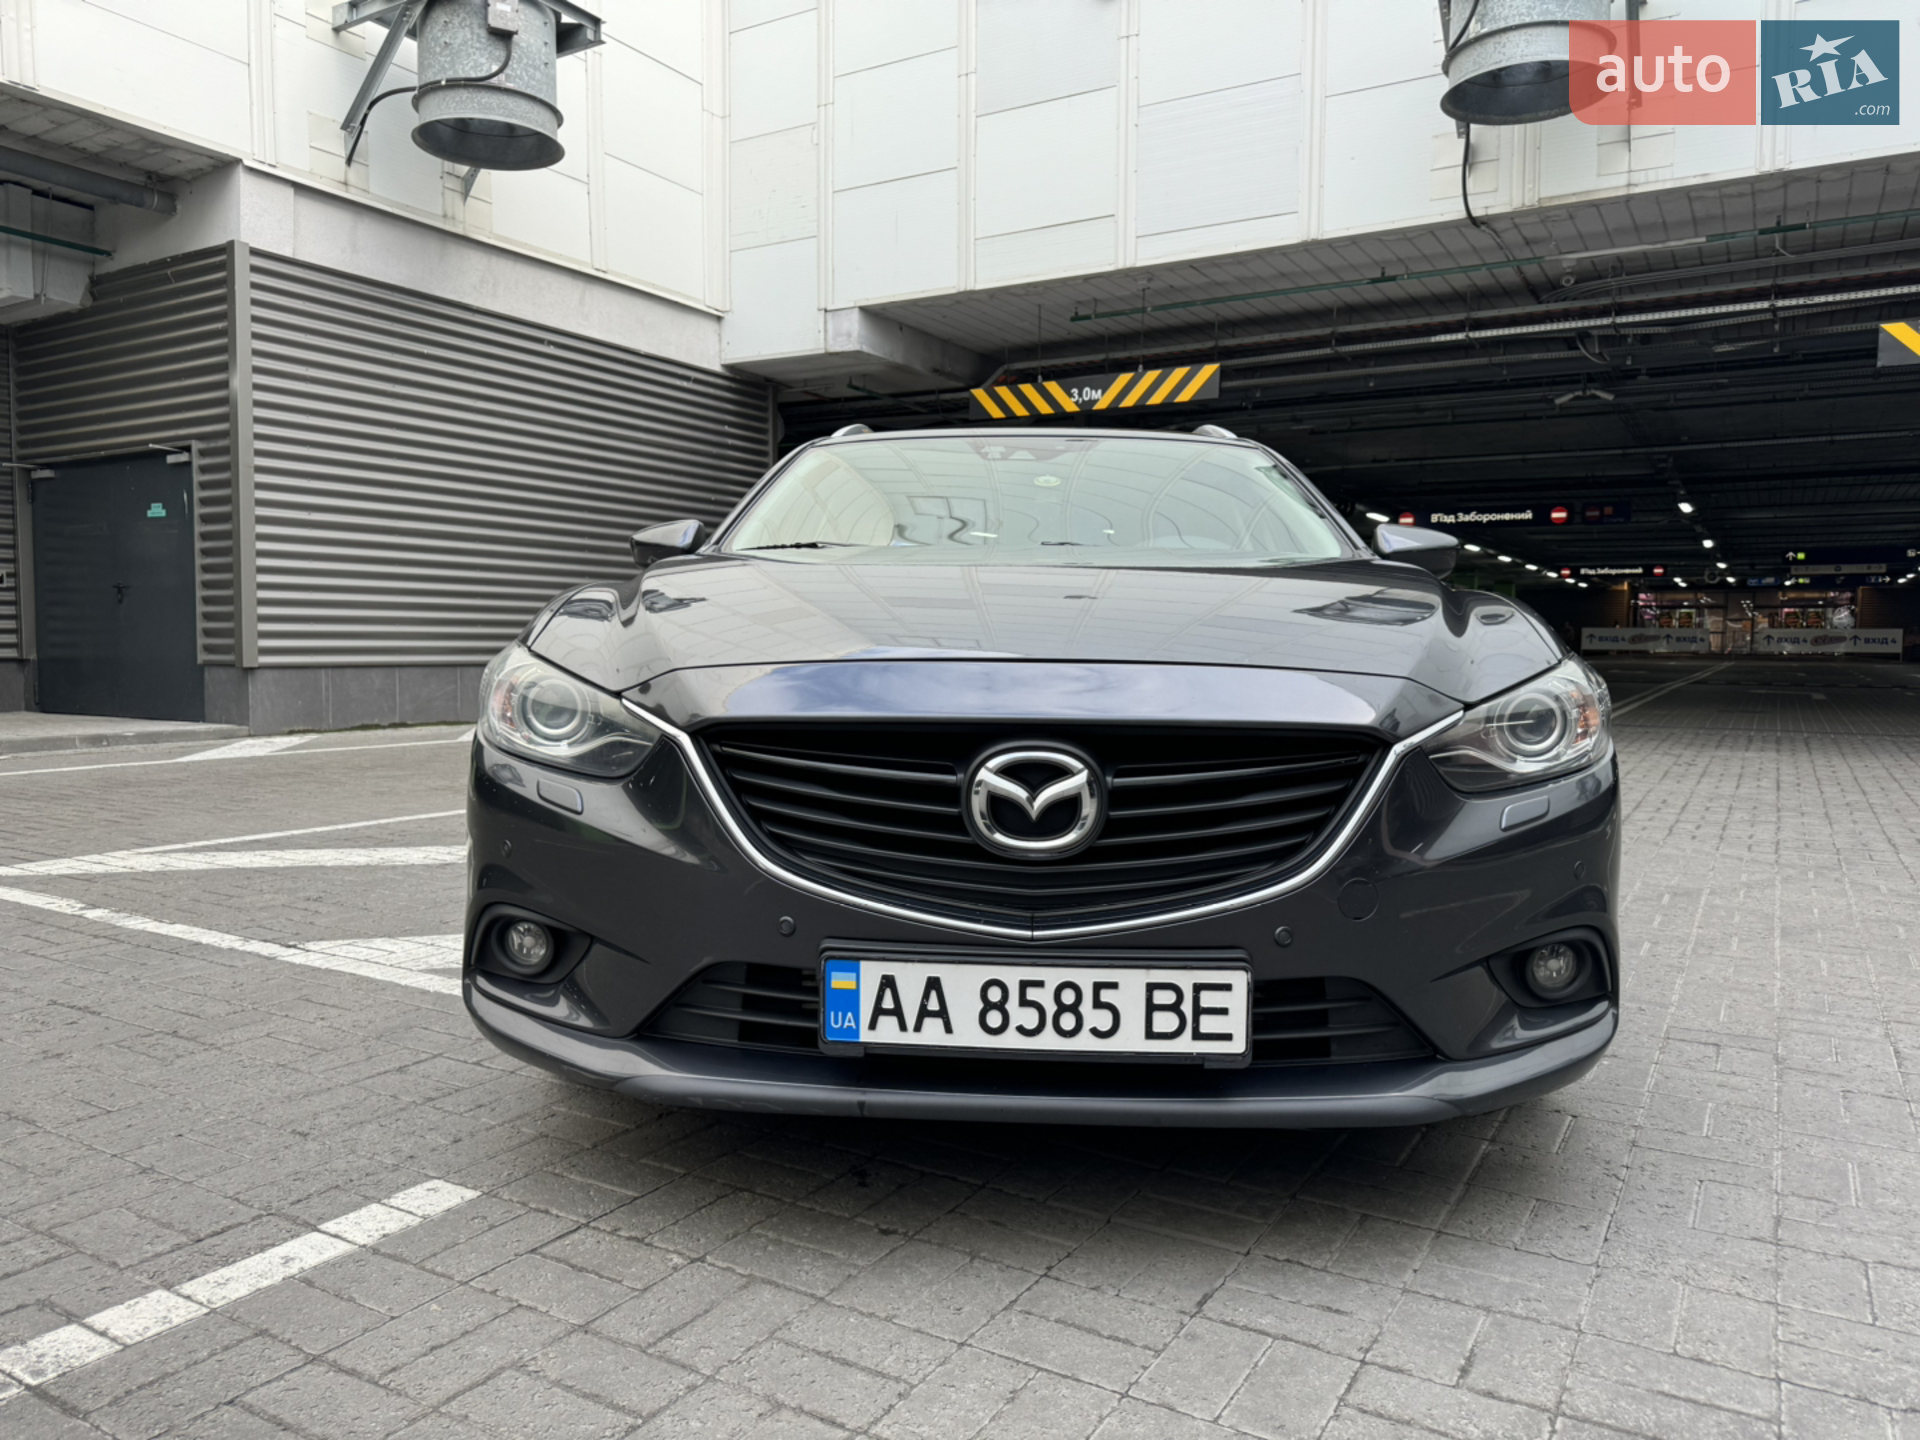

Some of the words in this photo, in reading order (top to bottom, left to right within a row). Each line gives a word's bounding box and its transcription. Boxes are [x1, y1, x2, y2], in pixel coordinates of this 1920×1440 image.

[1456, 509, 1533, 524] Заборонений
[867, 973, 955, 1034] AA
[977, 977, 1122, 1039] 8585
[1143, 981, 1234, 1042] BE
[830, 1011, 857, 1030] UA
